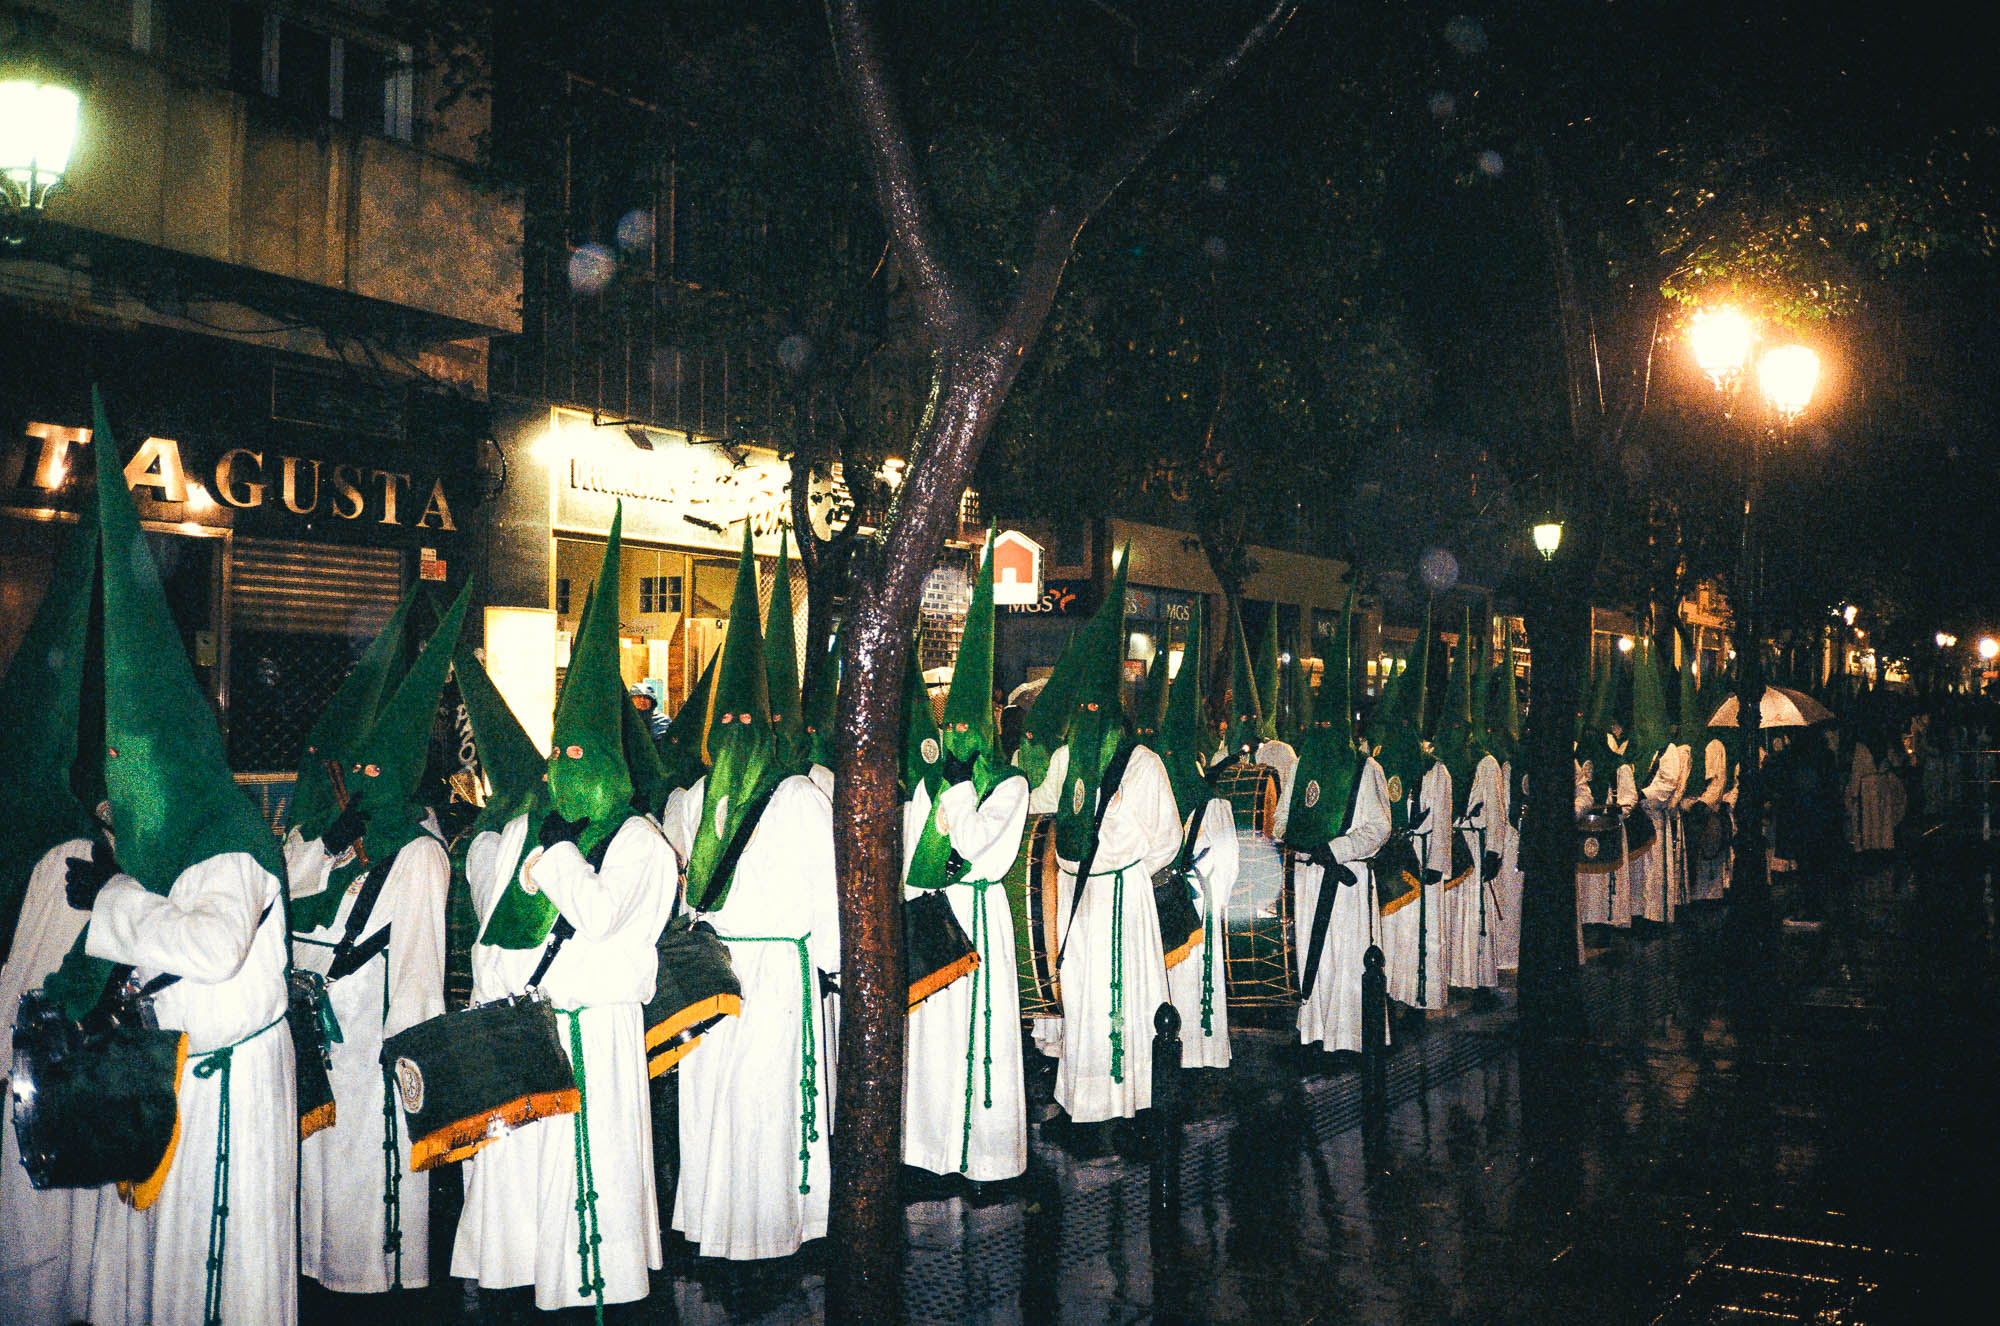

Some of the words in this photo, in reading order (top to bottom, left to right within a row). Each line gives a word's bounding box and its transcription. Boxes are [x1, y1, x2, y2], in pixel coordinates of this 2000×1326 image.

[215, 448, 457, 531] GUSTA
[1008, 595, 1053, 614] MGS
[1167, 603, 1190, 621] MGS
